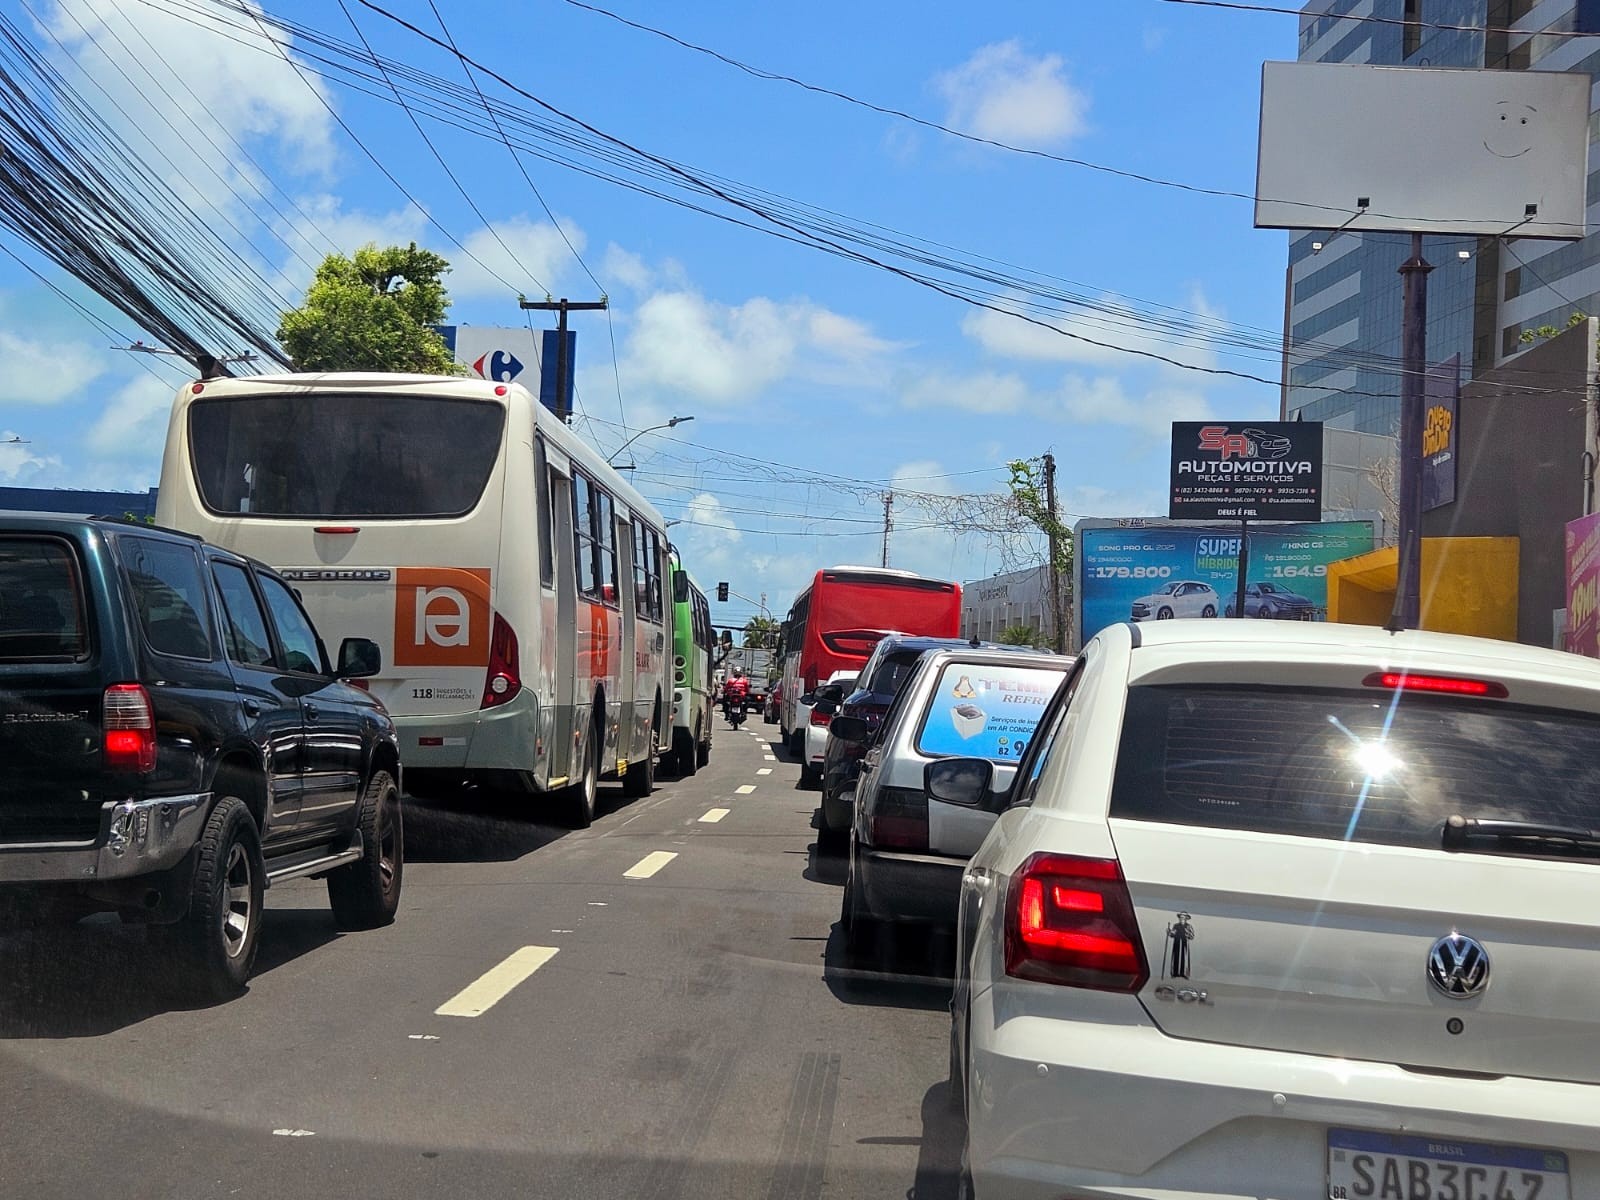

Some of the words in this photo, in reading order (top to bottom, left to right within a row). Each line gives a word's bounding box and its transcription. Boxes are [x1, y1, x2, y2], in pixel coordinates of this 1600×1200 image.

[1198, 426, 1248, 460] SA
[1178, 460, 1312, 474] AUTOMOTIVA
[1198, 475, 1231, 483] PEÇAS
[1244, 475, 1294, 483] SERVIÇOS
[1238, 507, 1242, 516] É
[1096, 566, 1171, 578] 179.800
[1272, 565, 1328, 577] 164.9
[412, 688, 433, 699] 118
[1002, 694, 1048, 705] REFRI
[1009, 726, 1035, 734] CONDIC
[998, 747, 1009, 756] 82
[1428, 1143, 1465, 1157] BRASIL
[1352, 1155, 1544, 1200] SAB3C47
[1333, 1185, 1347, 1200] BR
